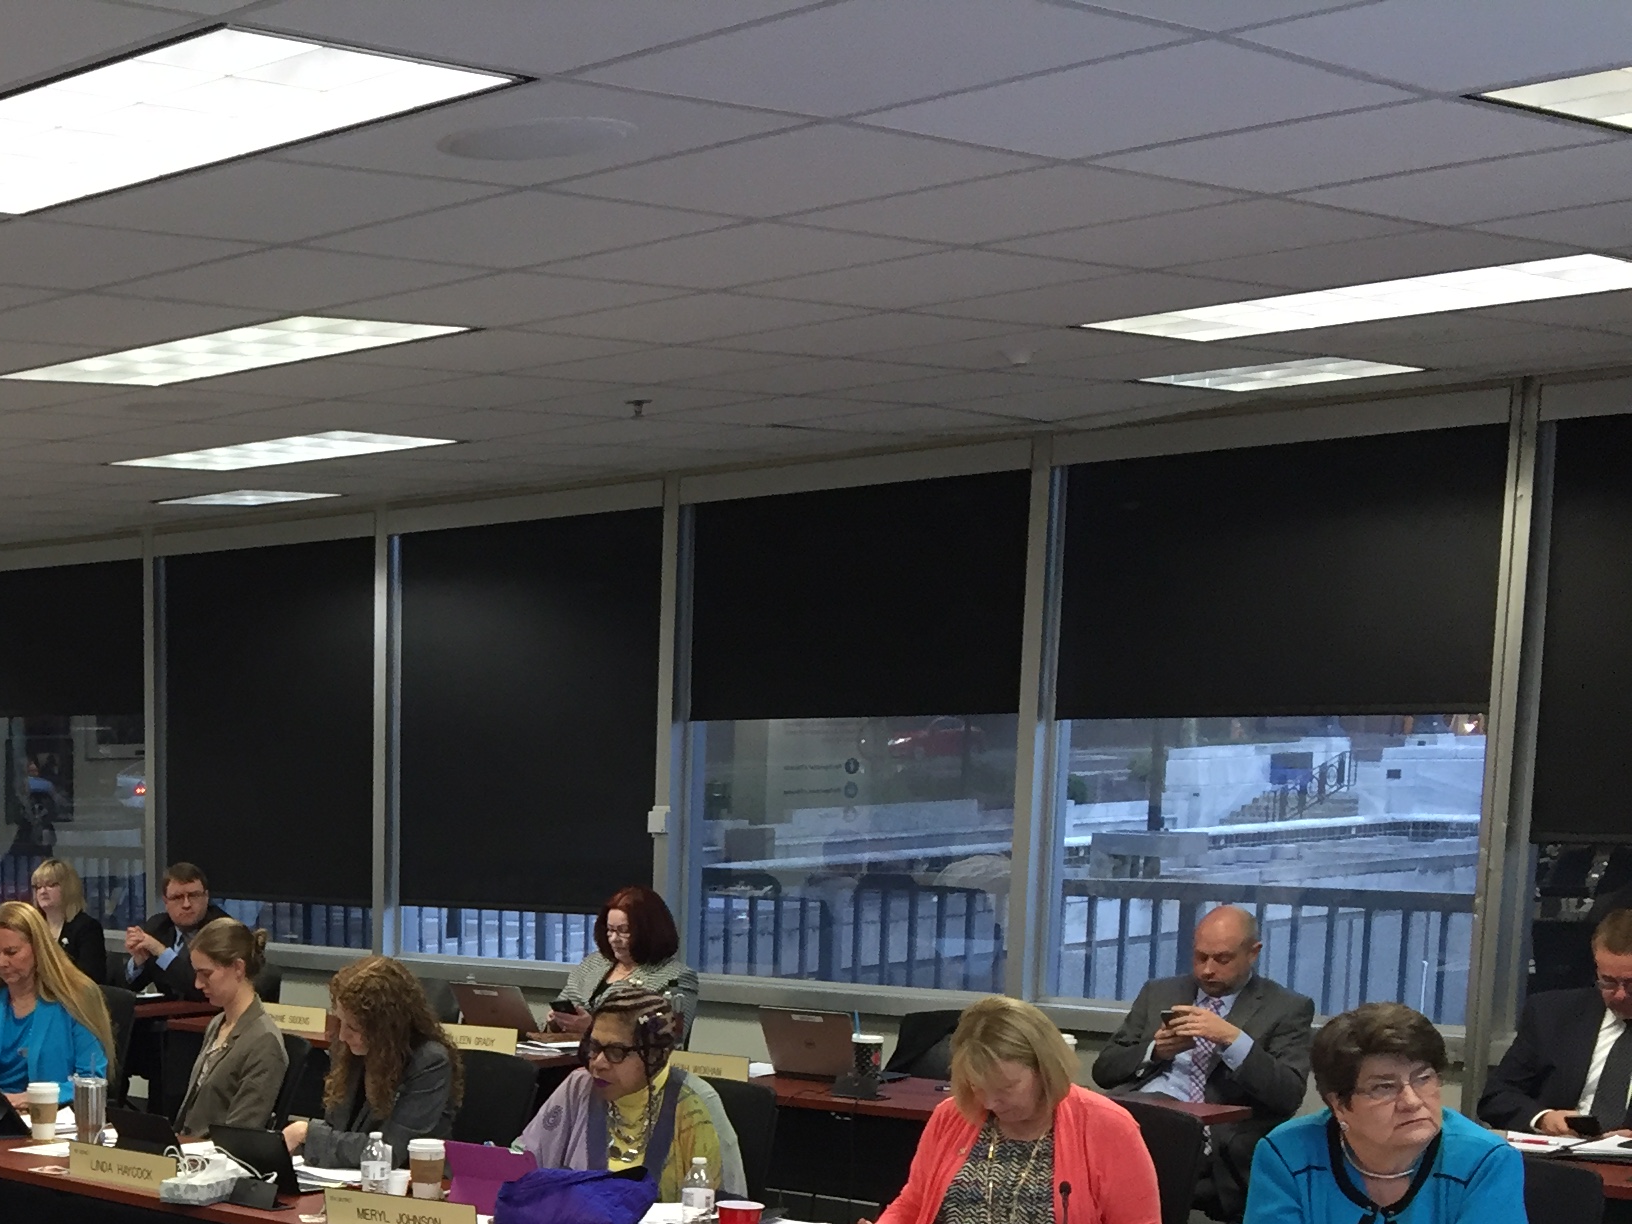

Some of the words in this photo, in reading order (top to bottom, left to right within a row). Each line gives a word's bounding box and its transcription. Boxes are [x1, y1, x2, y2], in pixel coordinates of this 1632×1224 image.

[89, 1159, 114, 1173] LINDA
[116, 1163, 153, 1181] HAYCOCK
[356, 1207, 391, 1224] MERYL
